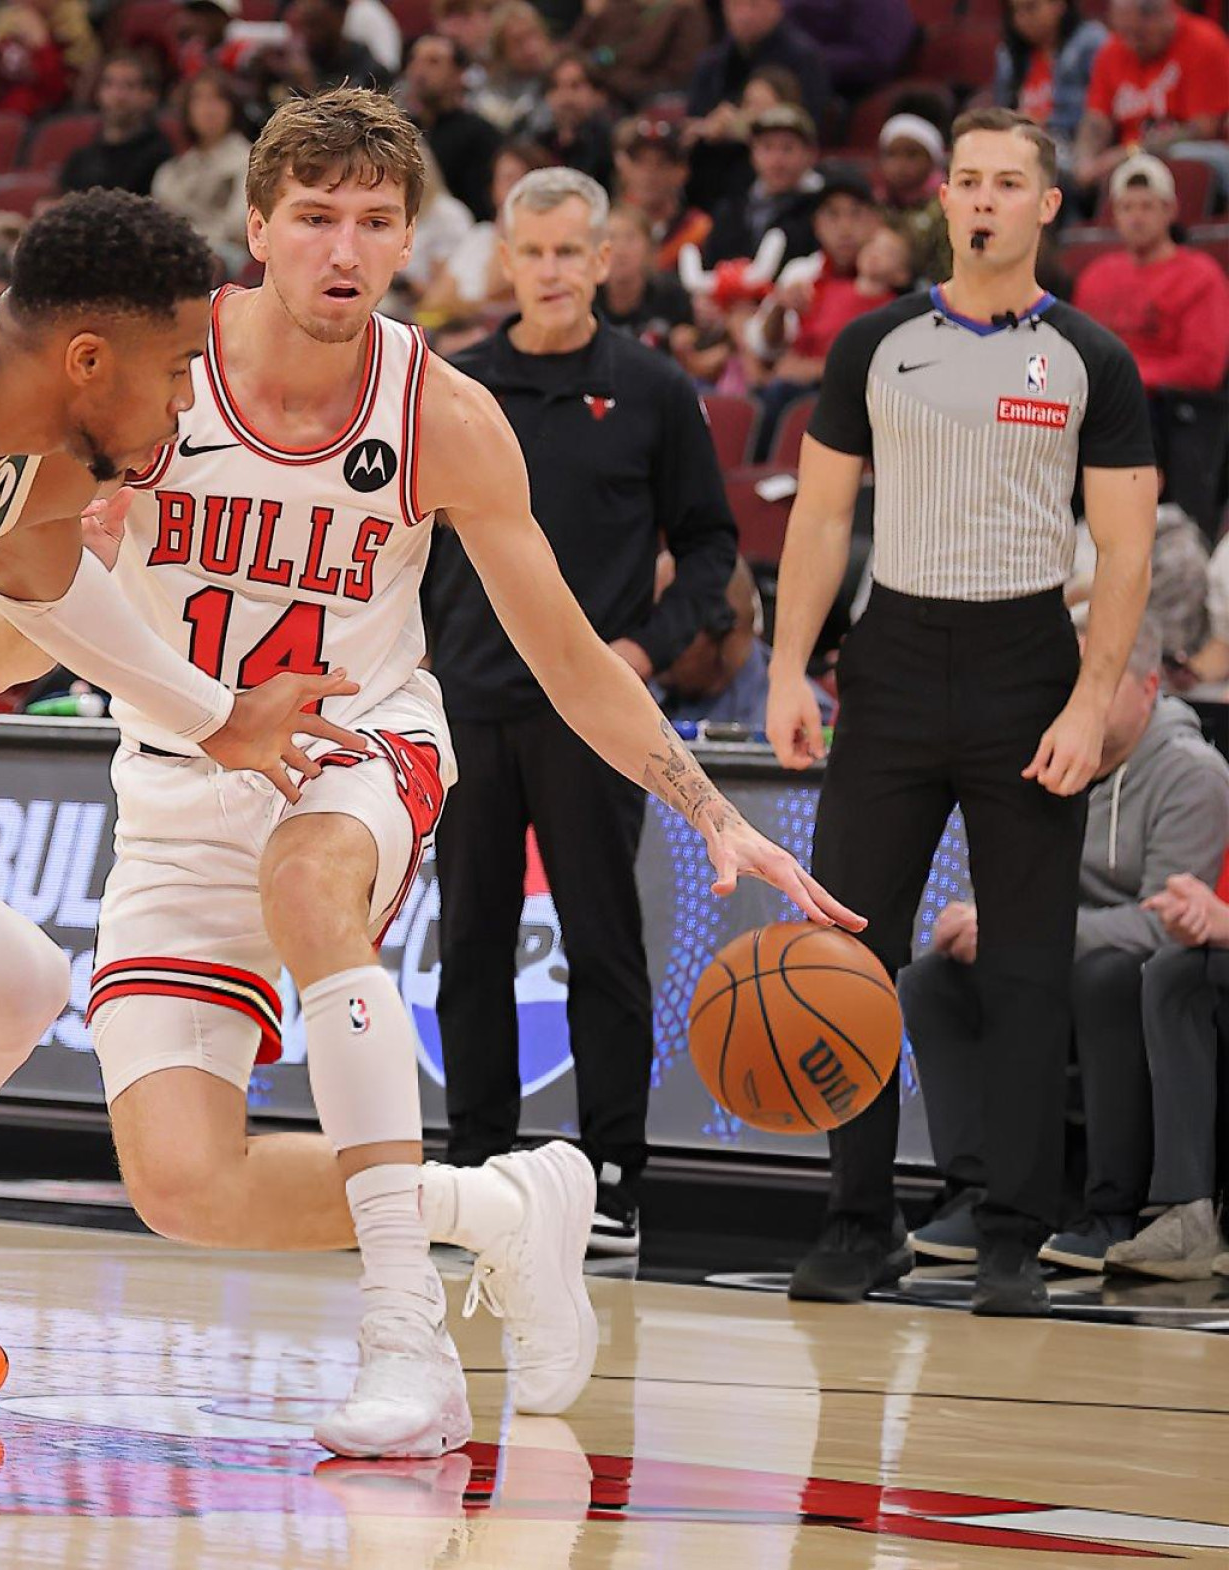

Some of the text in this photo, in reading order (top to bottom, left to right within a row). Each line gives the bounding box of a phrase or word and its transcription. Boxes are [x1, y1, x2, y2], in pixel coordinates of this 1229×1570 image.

[999, 400, 1066, 425] Emirates
[146, 490, 394, 603] BULLS
[182, 585, 330, 715] 14
